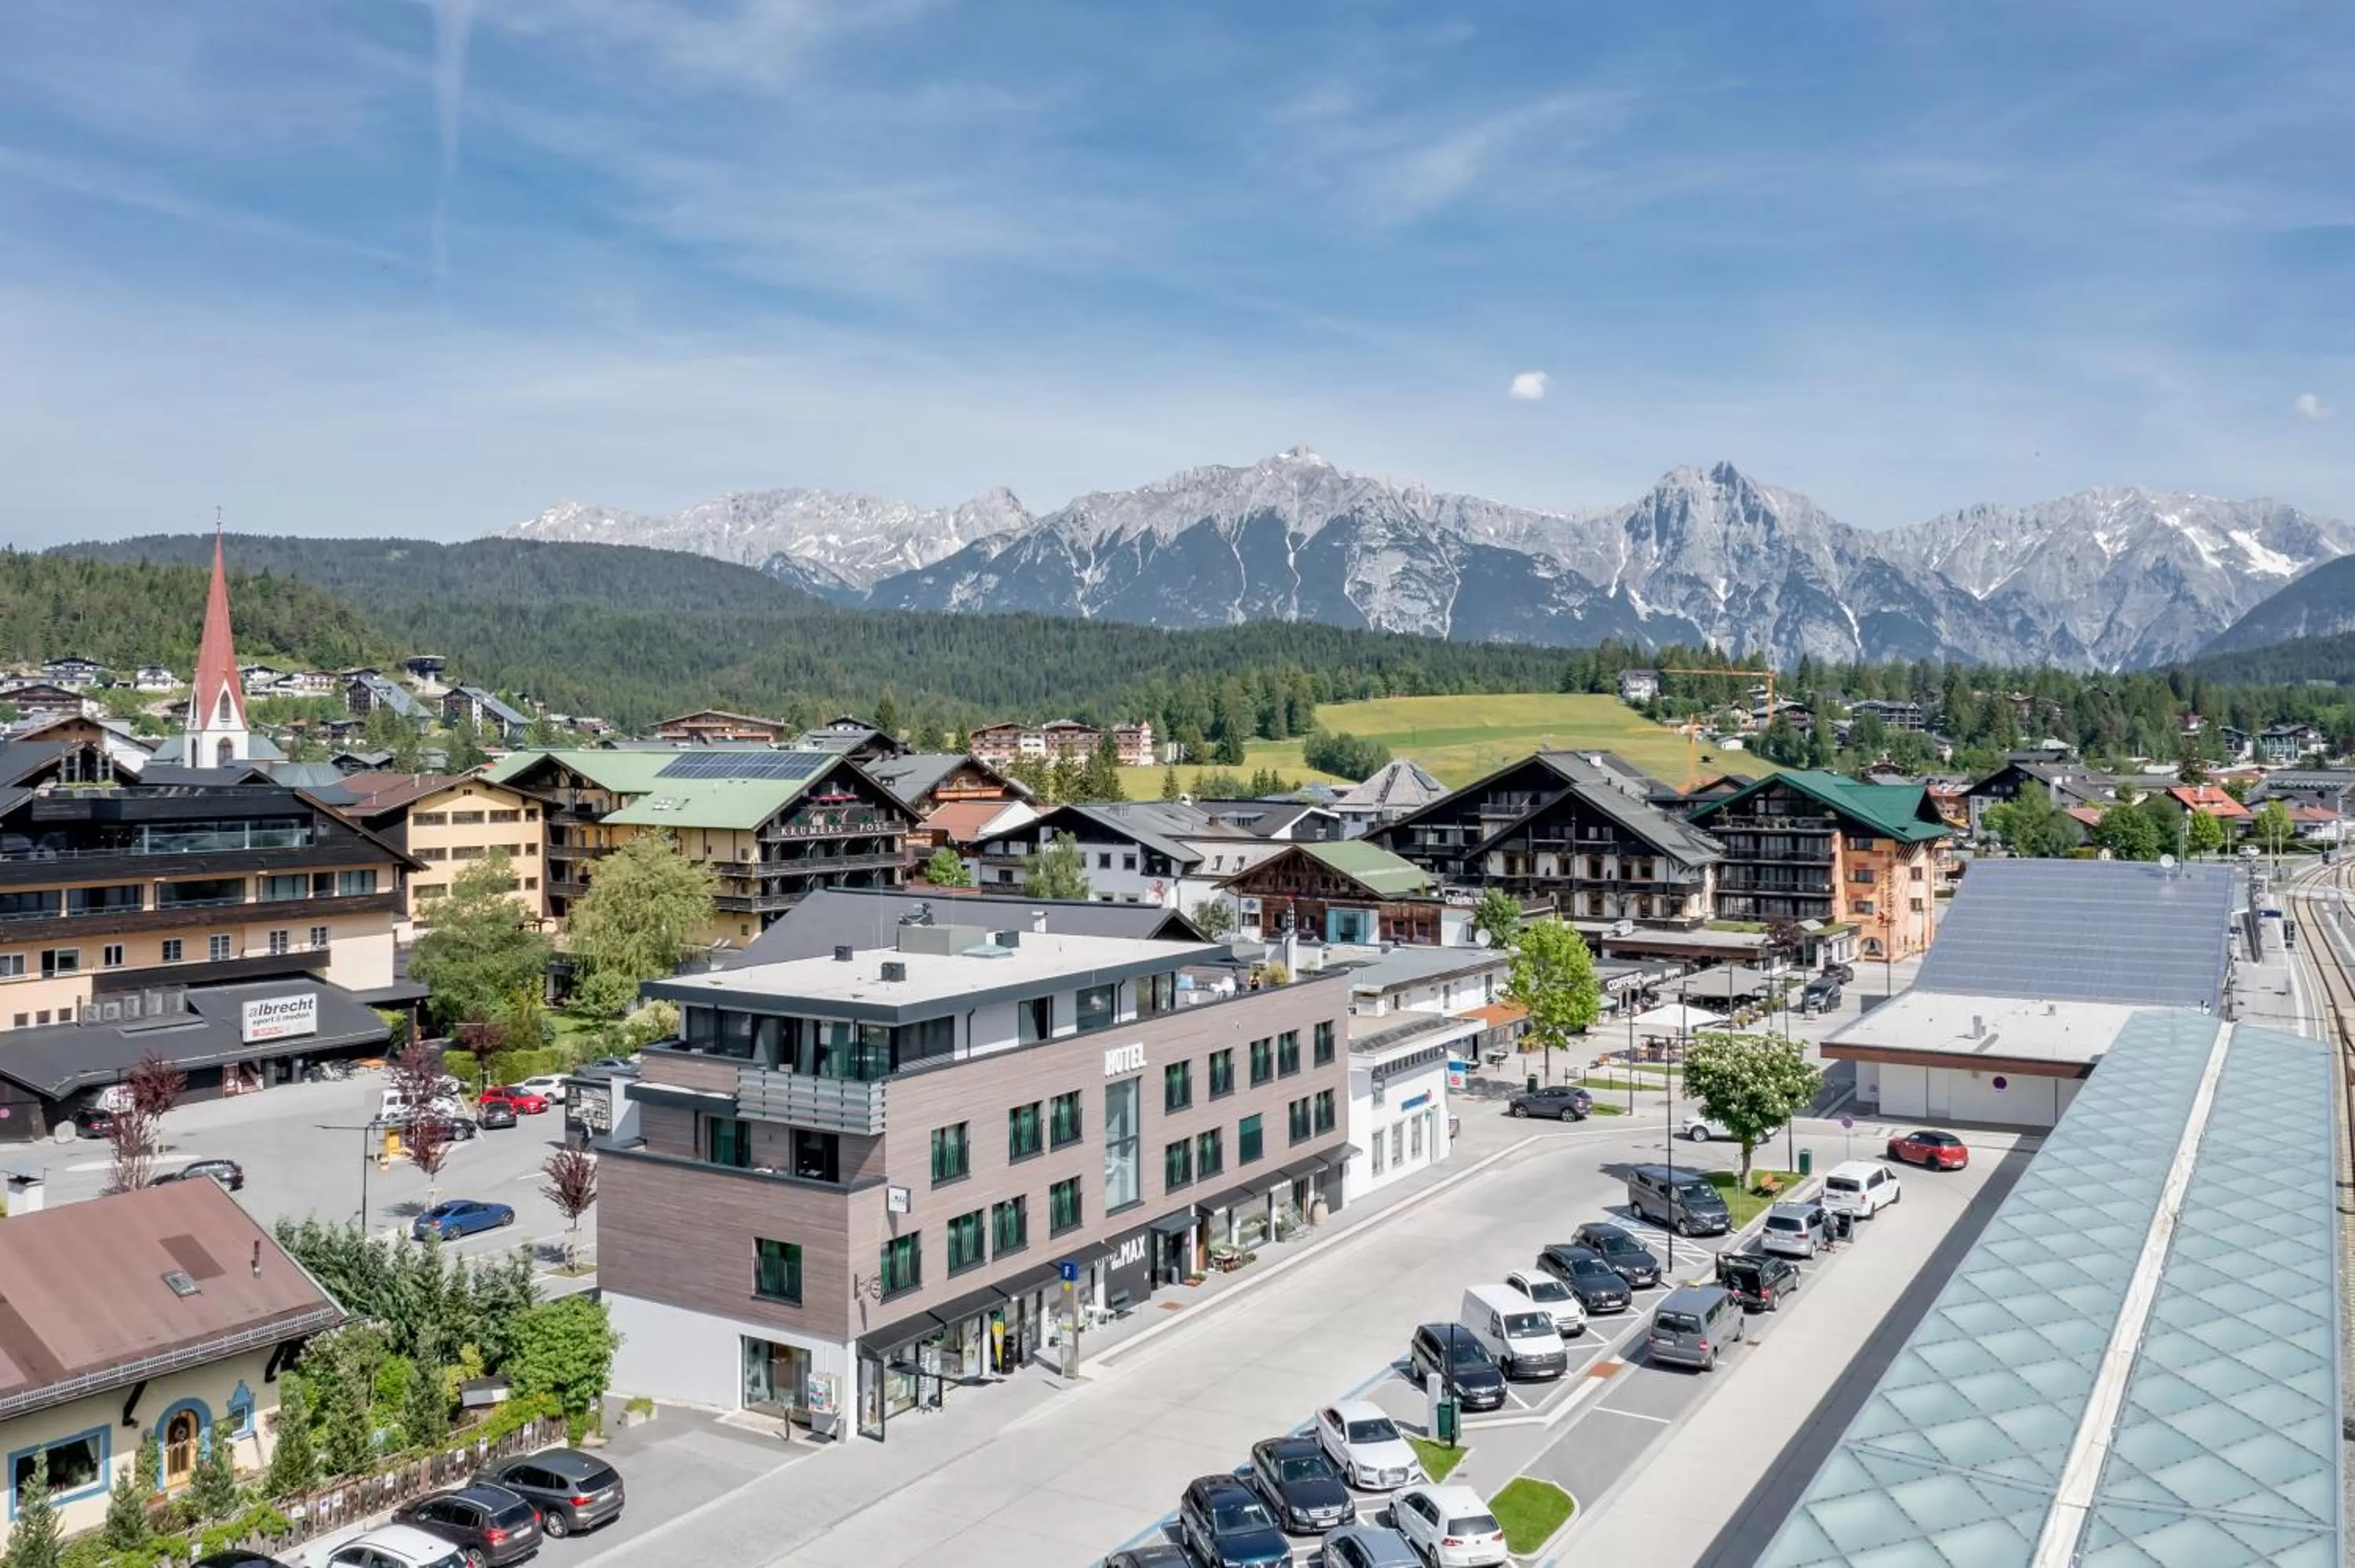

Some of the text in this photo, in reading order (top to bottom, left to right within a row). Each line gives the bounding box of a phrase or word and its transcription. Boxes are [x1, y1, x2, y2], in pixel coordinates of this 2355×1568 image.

[249, 998, 313, 1018] albrecht
[252, 1016, 275, 1027] sport
[1104, 1042, 1148, 1075] HOTEL
[1120, 1234, 1145, 1266] MAX
